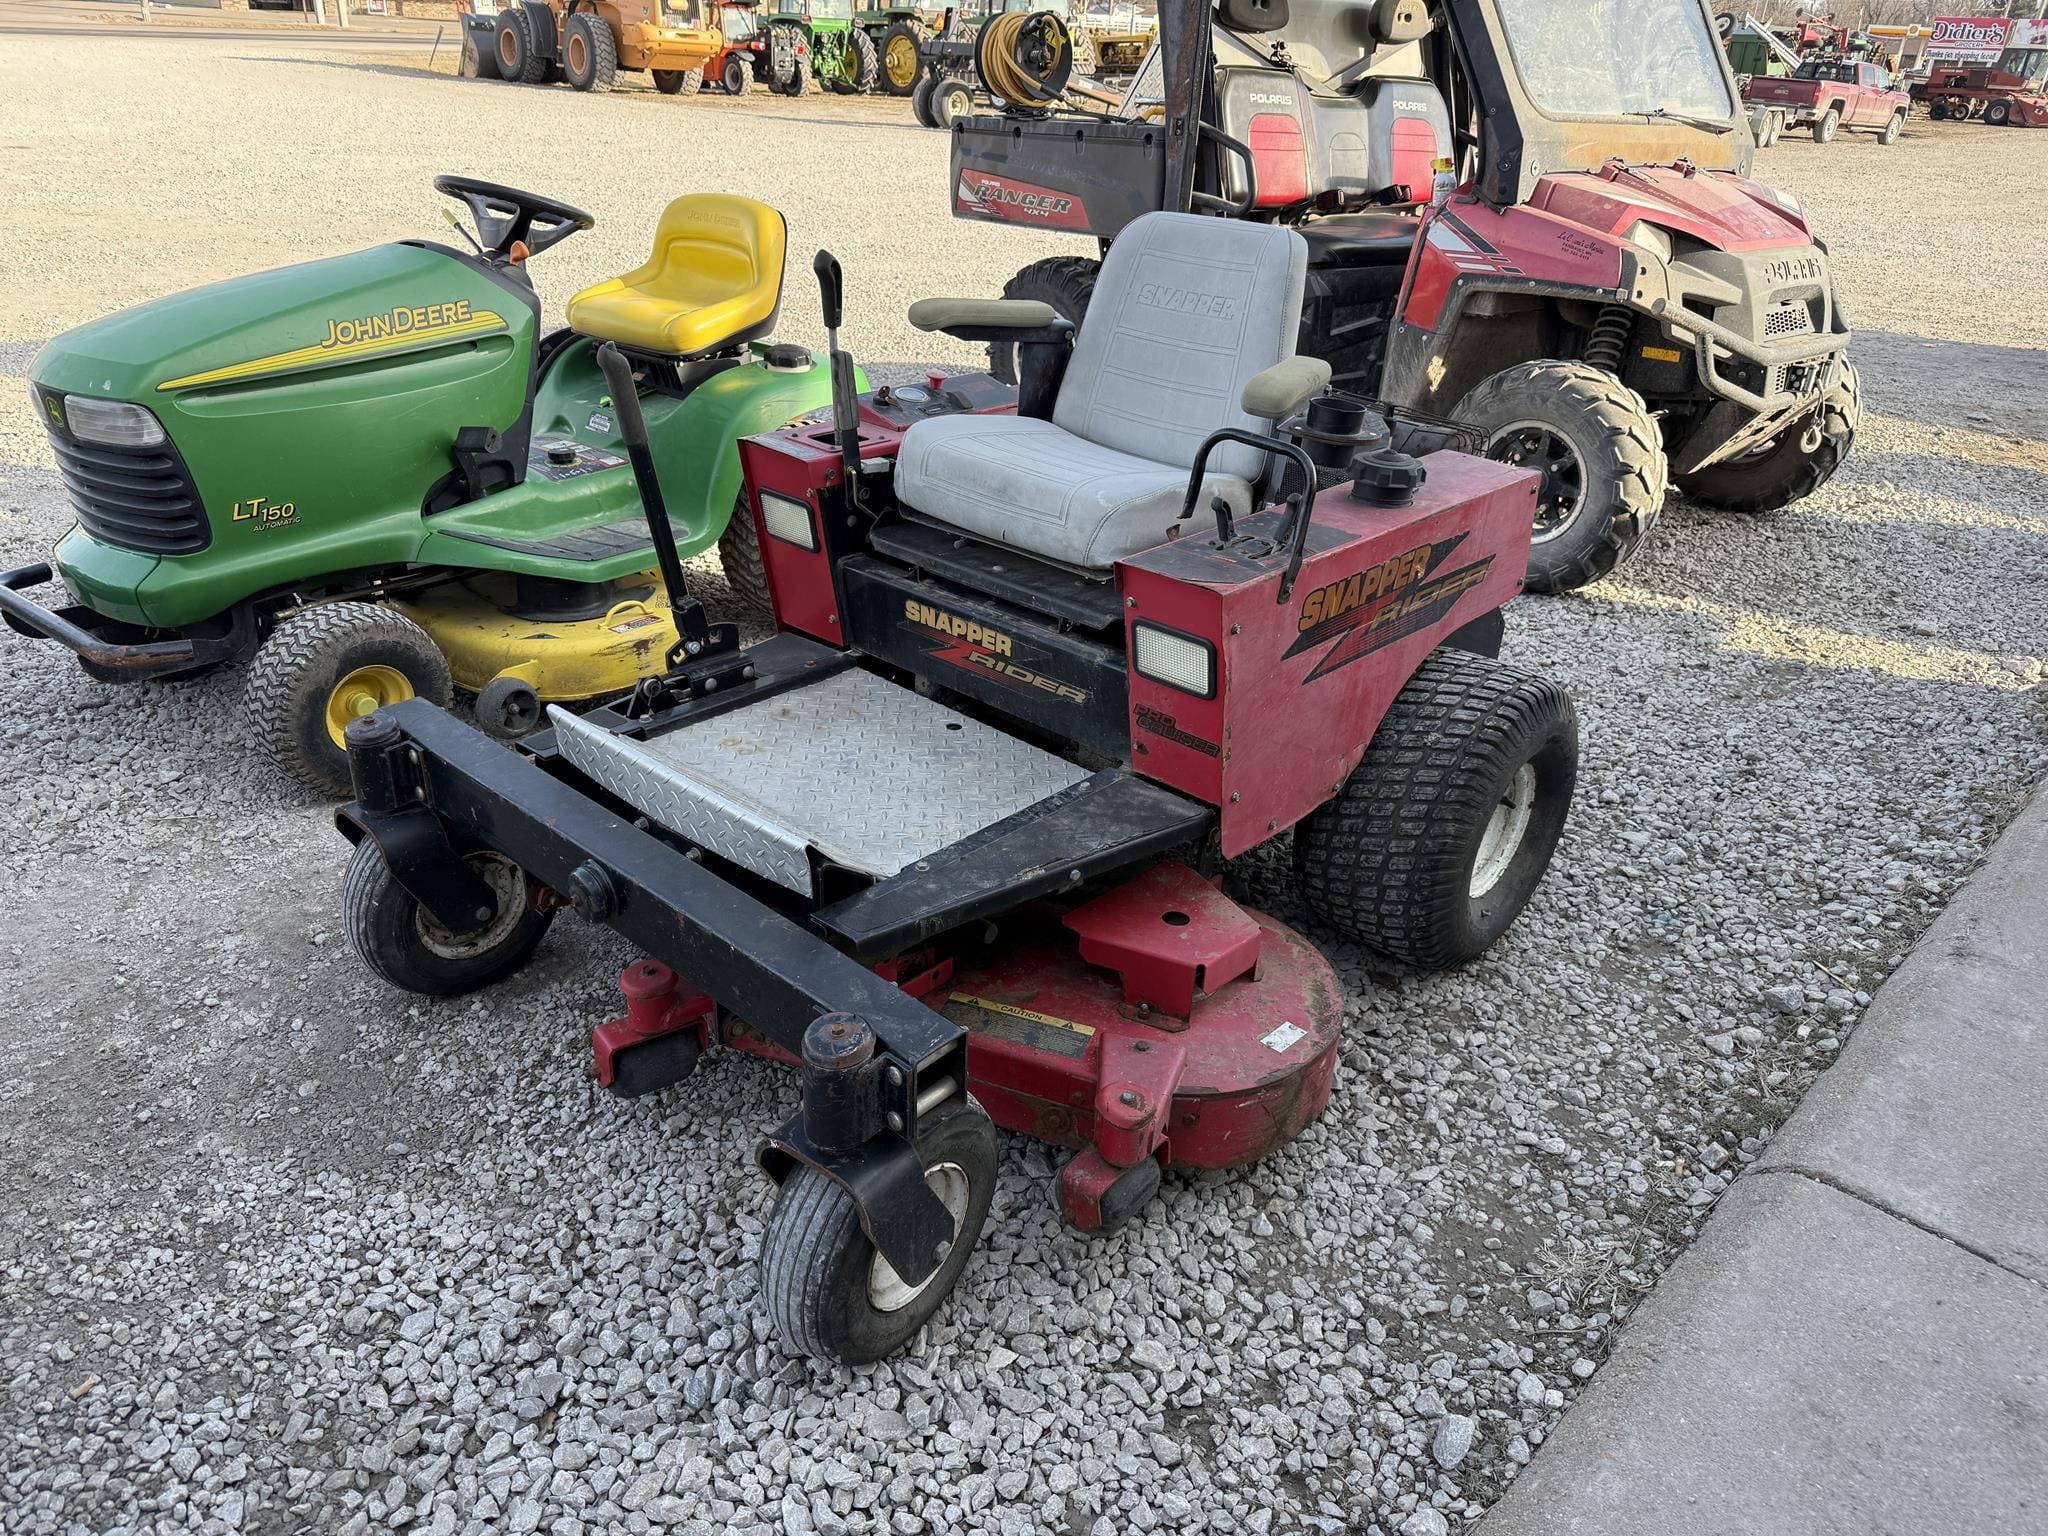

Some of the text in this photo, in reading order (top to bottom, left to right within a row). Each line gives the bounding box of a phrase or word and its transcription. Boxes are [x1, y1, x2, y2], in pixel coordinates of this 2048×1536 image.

[1930, 21, 2004, 44] Didier's
[1249, 93, 1293, 106] POLARIS
[1392, 100, 1428, 112] POLARIS
[974, 184, 1073, 214] RANGER
[1764, 257, 1823, 284] POLARIS
[1136, 283, 1237, 320] SNAPPER
[320, 299, 473, 349] JOHN DEERE
[253, 516, 303, 533] AUTOMATIC
[1298, 543, 1432, 633] SNAPPER
[905, 600, 1013, 657] SNAPPER
[968, 650, 1087, 705] RIDER
[1136, 715, 1221, 758] CRUISER
[1000, 1005, 1043, 1021] CAUTION
